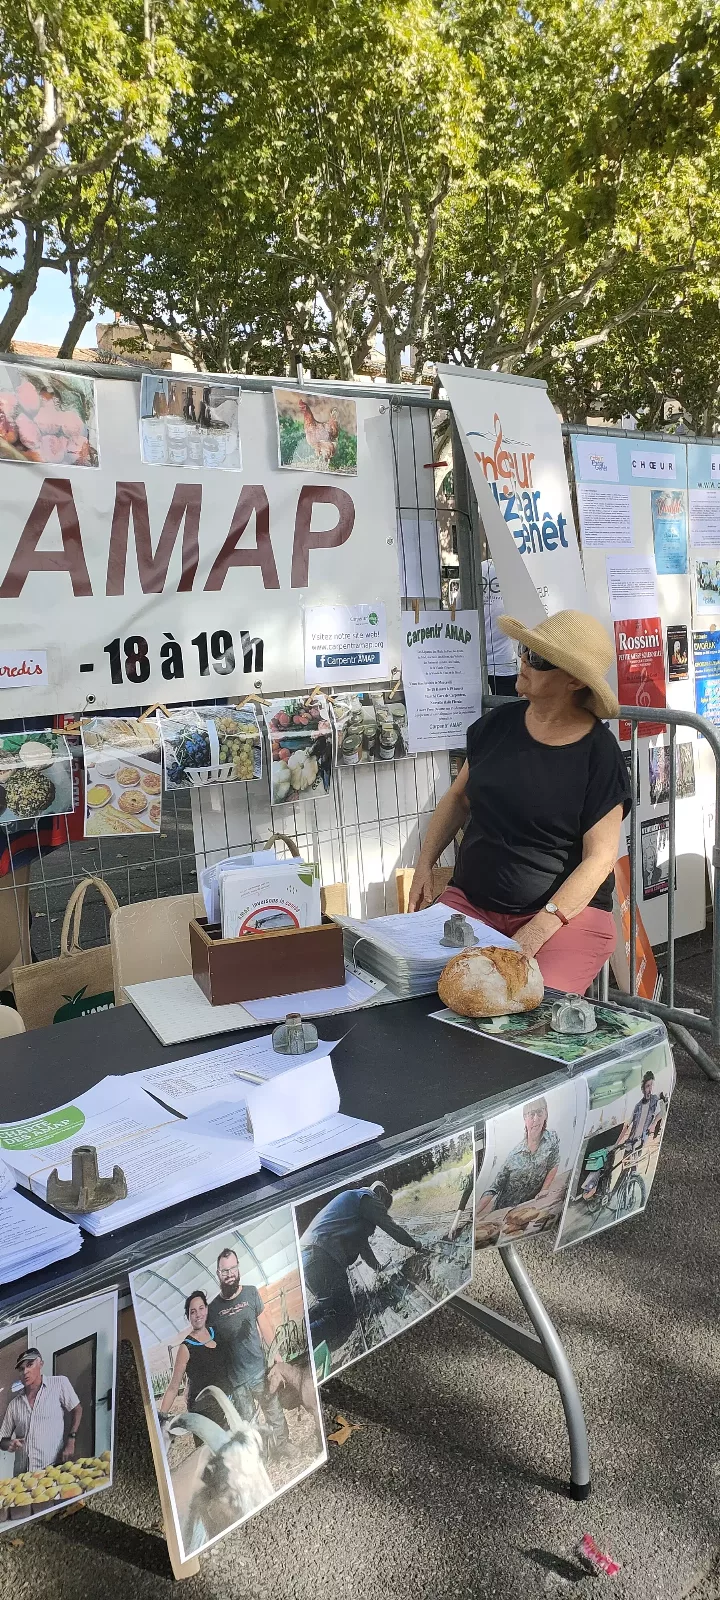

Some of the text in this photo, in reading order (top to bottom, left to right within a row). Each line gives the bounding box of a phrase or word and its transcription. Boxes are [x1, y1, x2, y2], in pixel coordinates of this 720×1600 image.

[632, 460, 673, 471] CHŒUR
[0, 478, 356, 598] AMAP
[311, 630, 380, 641] Visitez notre site web!
[444, 623, 472, 645] AMAP
[618, 628, 660, 651] Rossini
[103, 635, 151, 685] 18
[160, 632, 185, 681] à
[358, 654, 376, 663] AMAP
[0, 1120, 52, 1139] CHARTE
[4, 1134, 32, 1145] DES
